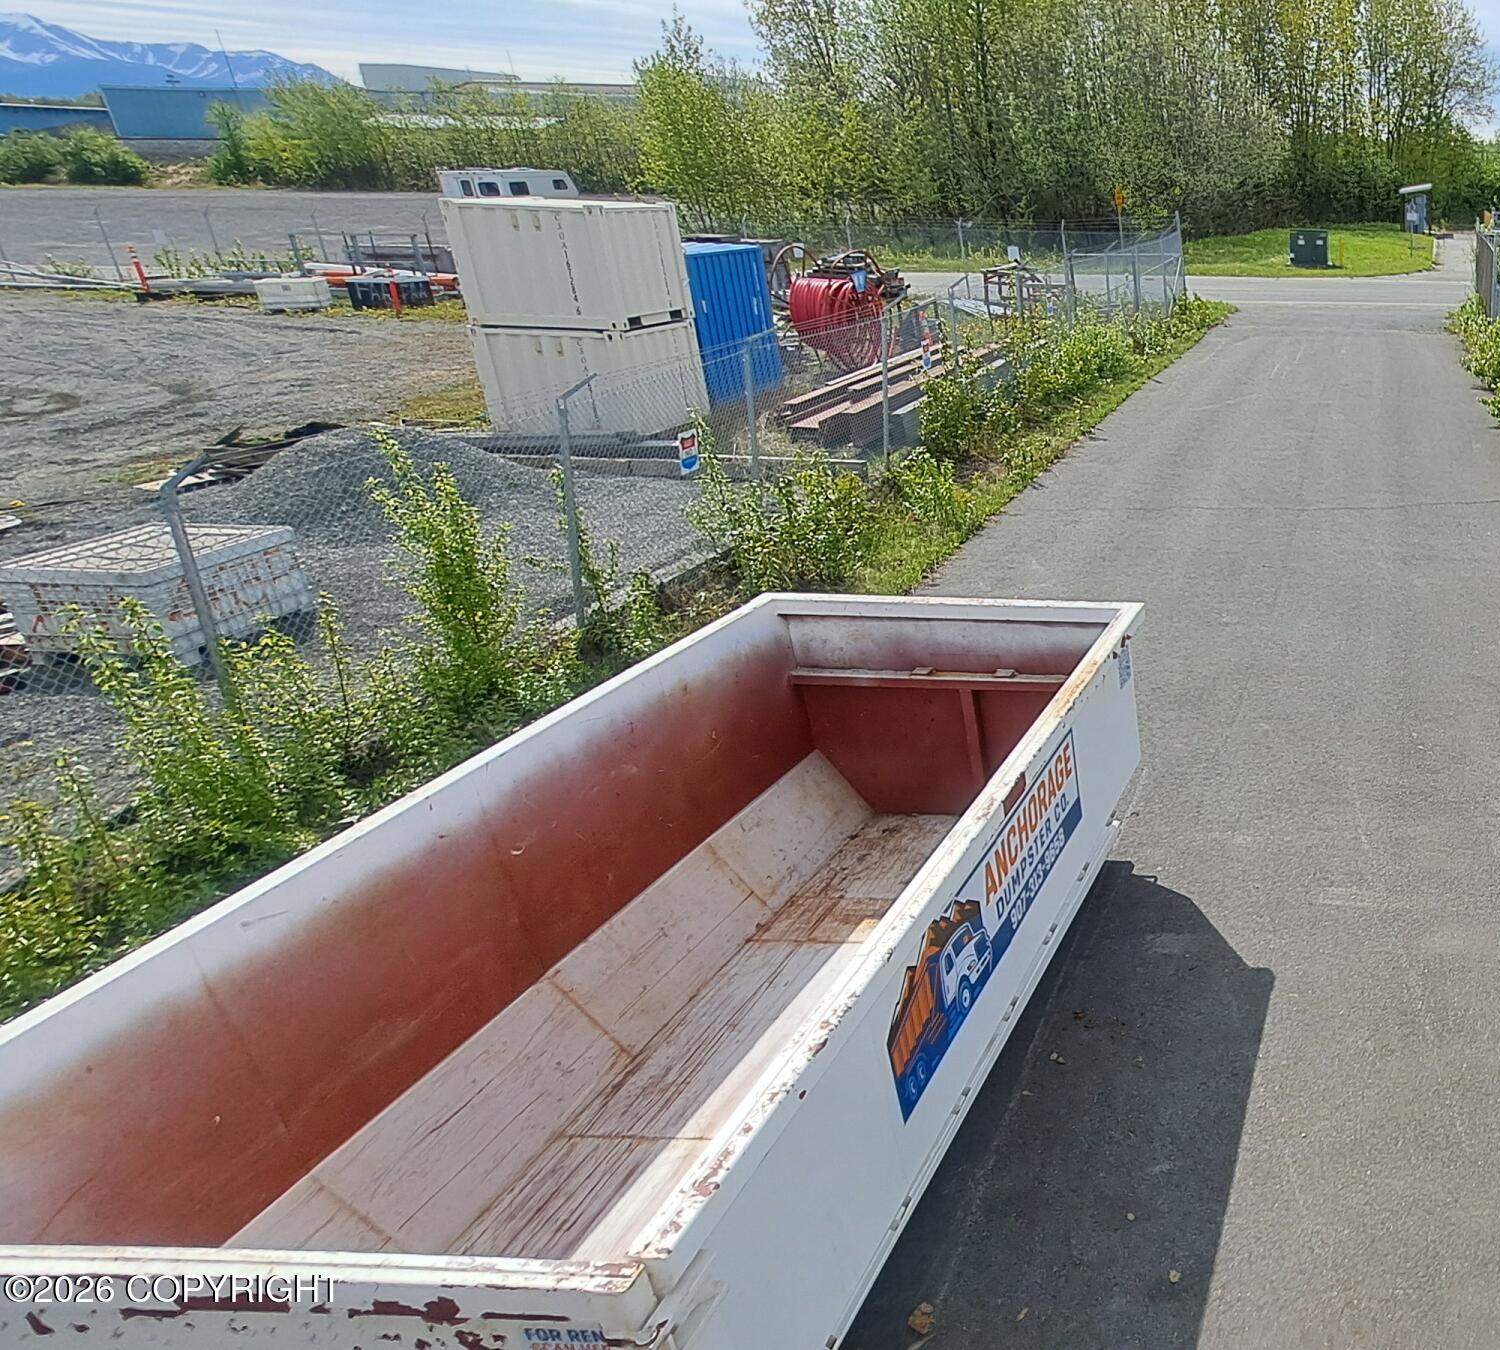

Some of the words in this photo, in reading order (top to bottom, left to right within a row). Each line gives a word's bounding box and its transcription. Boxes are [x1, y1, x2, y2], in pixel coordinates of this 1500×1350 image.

[983, 741, 1073, 906] ANCHORAGE
[995, 815, 1052, 921] DUMPSTER
[1053, 791, 1070, 823] CO.
[1009, 826, 1066, 929] 907-313-9658
[523, 1328, 561, 1341] FOR
[566, 1328, 607, 1343] REN
